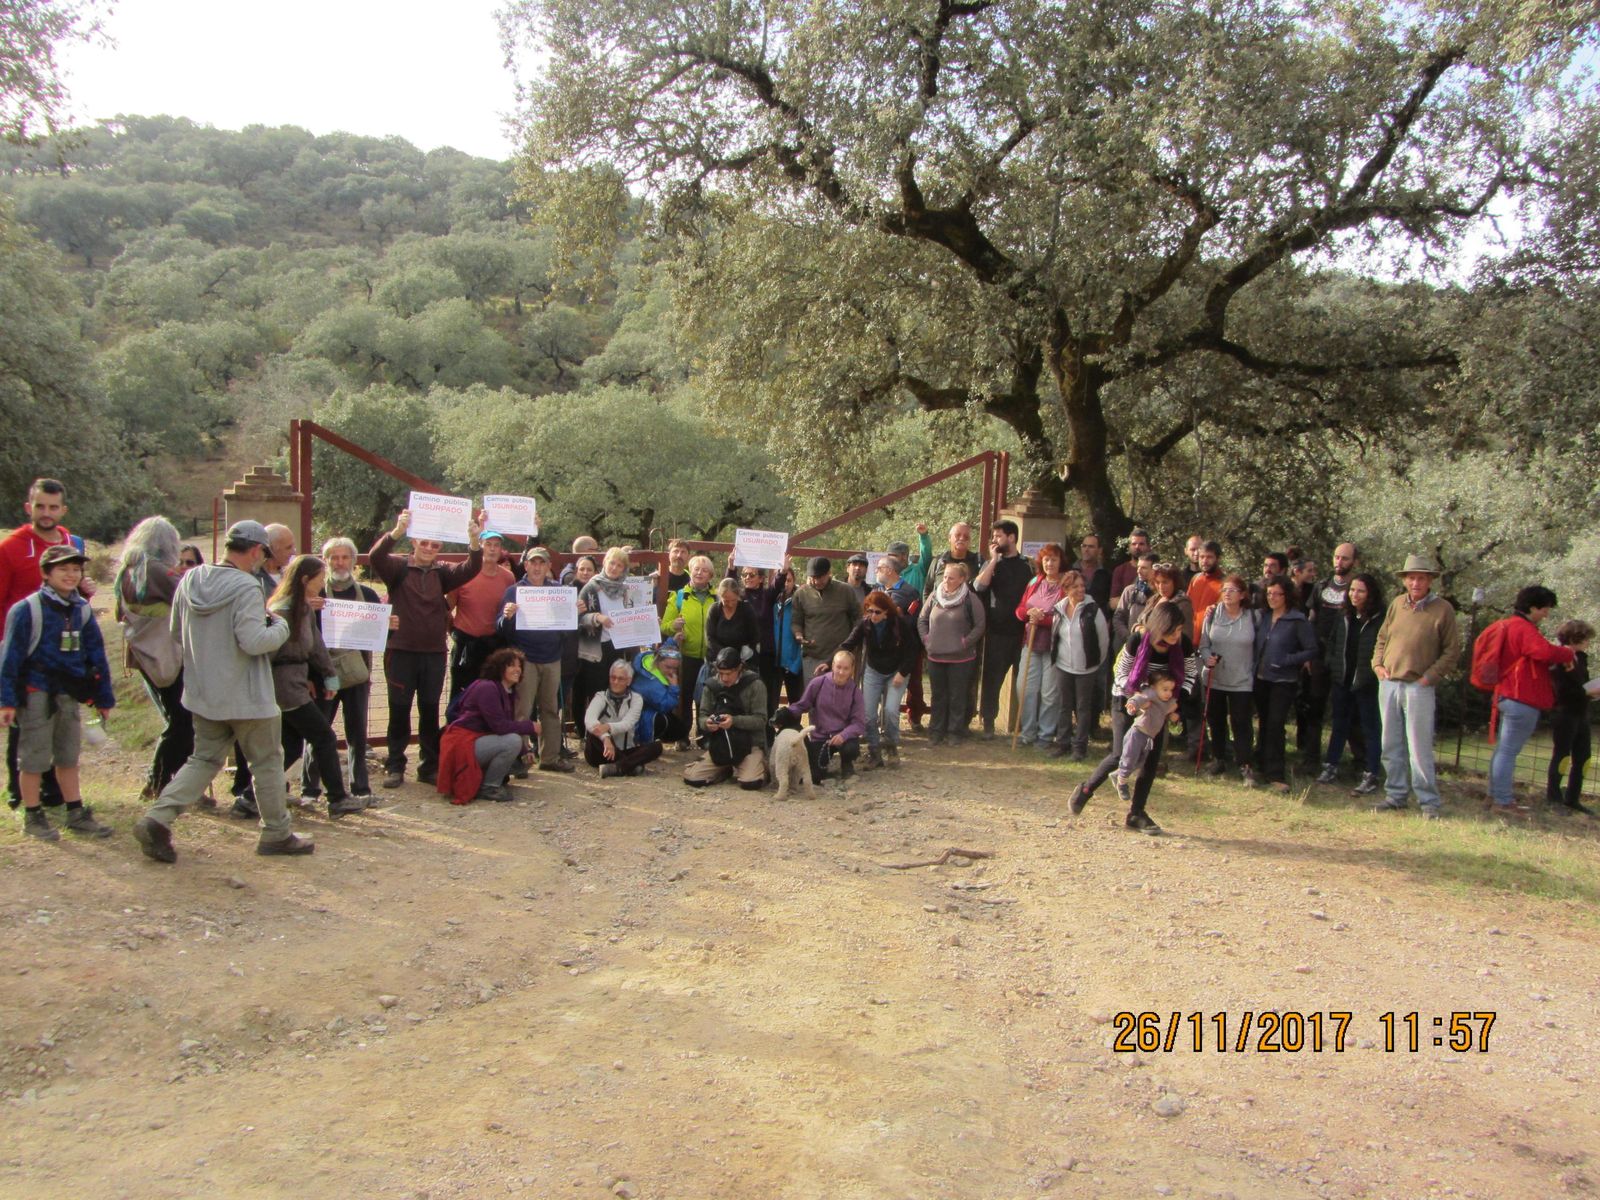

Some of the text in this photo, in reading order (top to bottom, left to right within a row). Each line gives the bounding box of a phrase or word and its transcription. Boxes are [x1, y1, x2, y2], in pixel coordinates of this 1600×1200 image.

[413, 493, 441, 503] Camino
[419, 502, 463, 514] USURPADO
[492, 503, 529, 511] USURPADO
[743, 537, 779, 546] USURPADO
[525, 595, 567, 603] USURPADO
[324, 600, 354, 610] Camino
[330, 610, 378, 621] USURPADO
[616, 614, 650, 624] USURPADO
